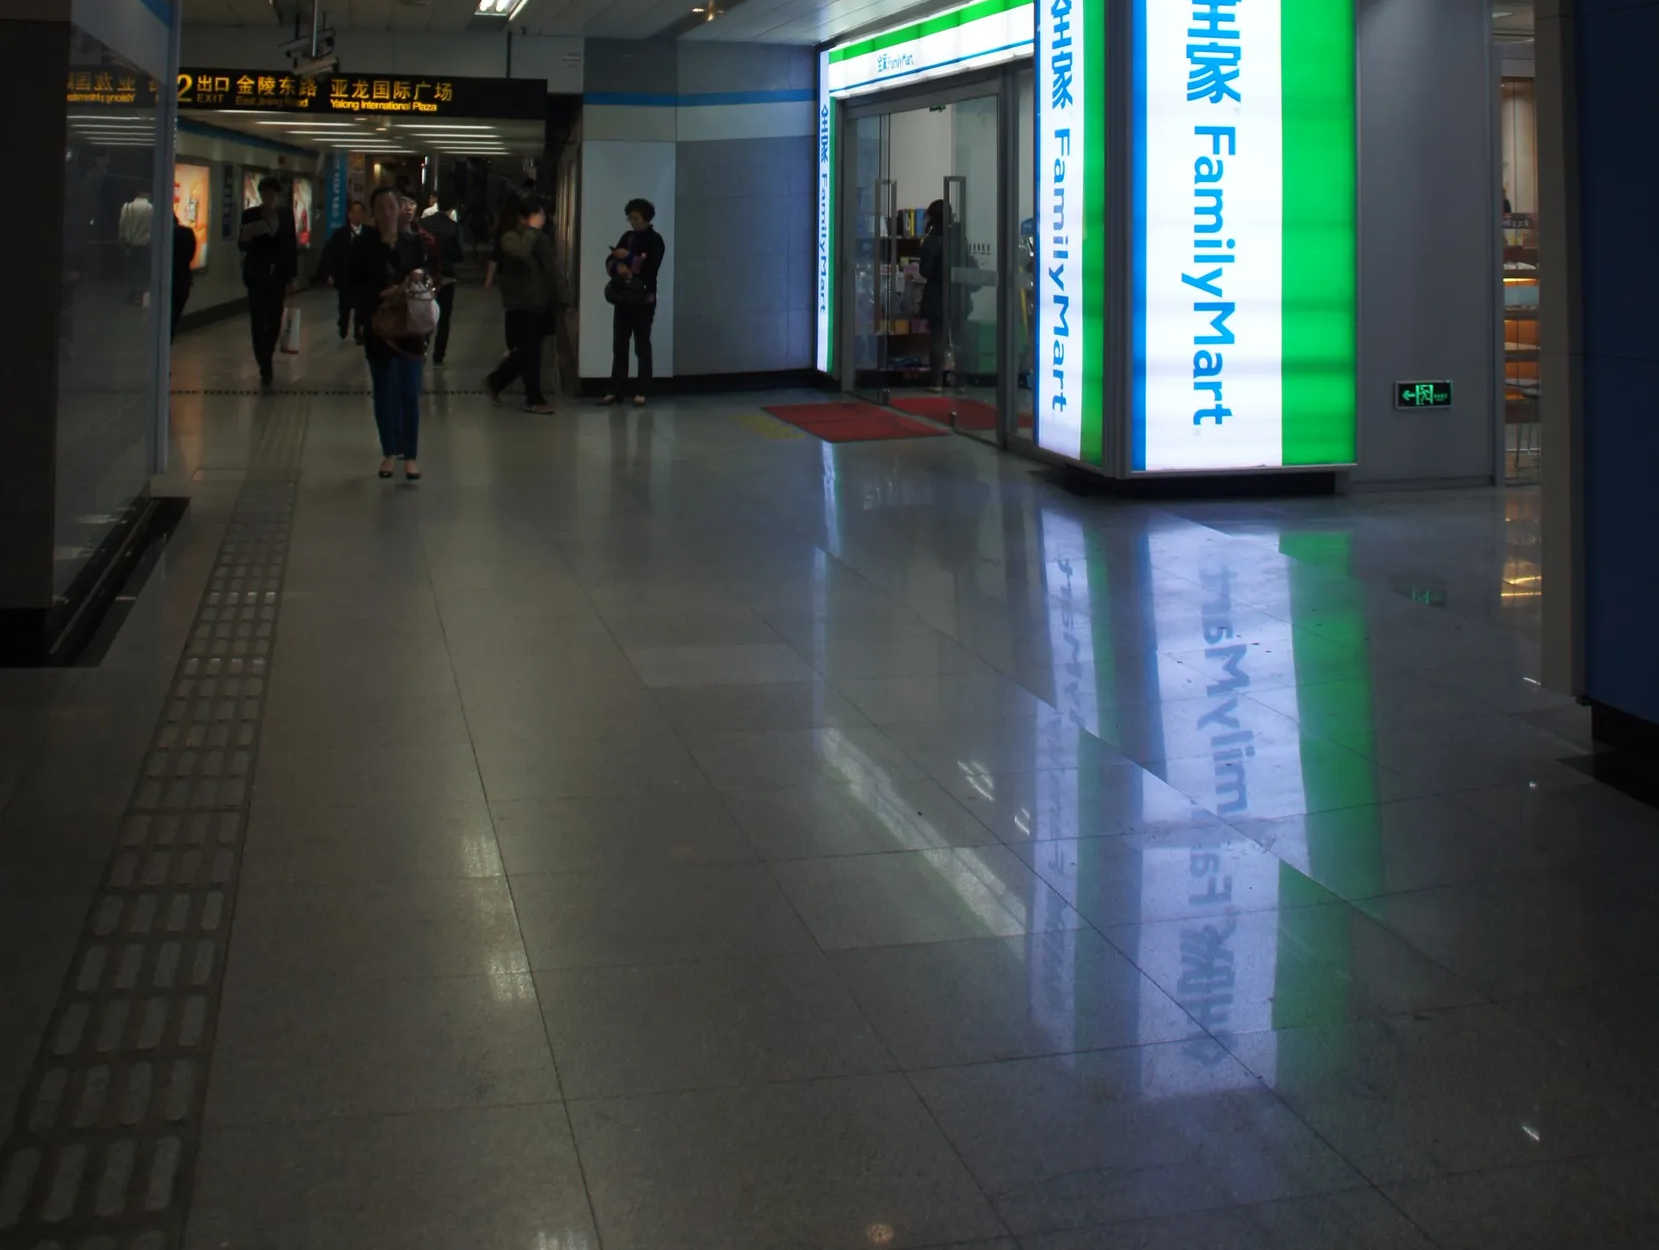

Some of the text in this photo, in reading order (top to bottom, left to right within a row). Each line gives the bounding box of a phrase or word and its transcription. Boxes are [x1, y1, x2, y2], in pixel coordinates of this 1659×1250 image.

[176, 73, 193, 102] 2
[197, 75, 230, 93] 出口
[236, 74, 318, 98] 金陵东路
[329, 78, 453, 102] 亚龙国际广场
[196, 93, 224, 104] EXIT
[329, 99, 438, 112] Yalong International Plaza
[818, 104, 829, 313] 全家 FamilyMart
[1048, 128, 1072, 413] FamilyMart
[1181, 125, 1236, 425] FamilyMart
